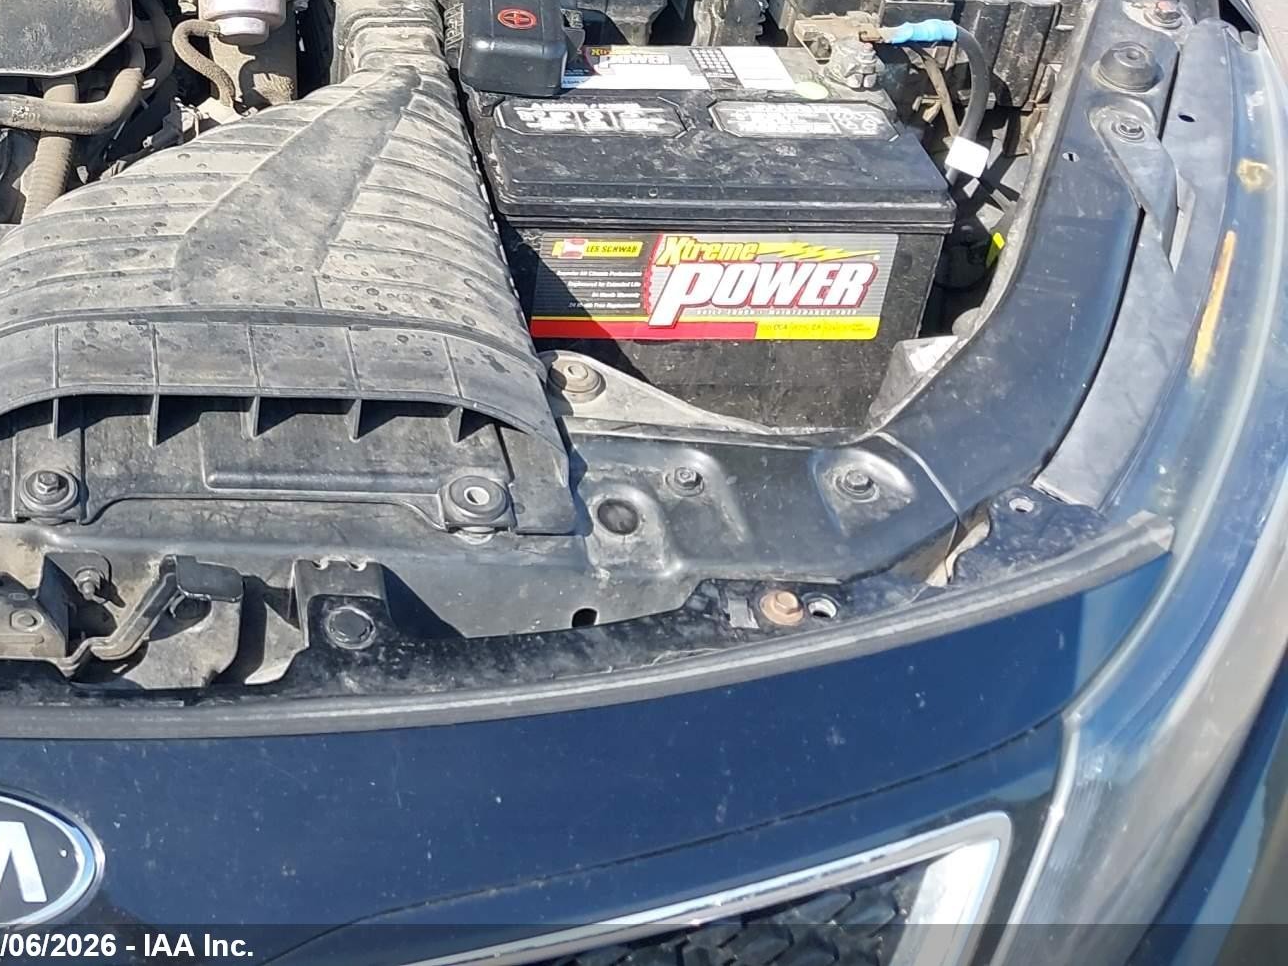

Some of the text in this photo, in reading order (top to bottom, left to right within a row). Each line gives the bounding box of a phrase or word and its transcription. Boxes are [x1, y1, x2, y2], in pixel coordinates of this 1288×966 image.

[585, 245, 638, 254] LES SCHWAB
[655, 235, 760, 267] Xtreme
[648, 261, 879, 328] POWER
